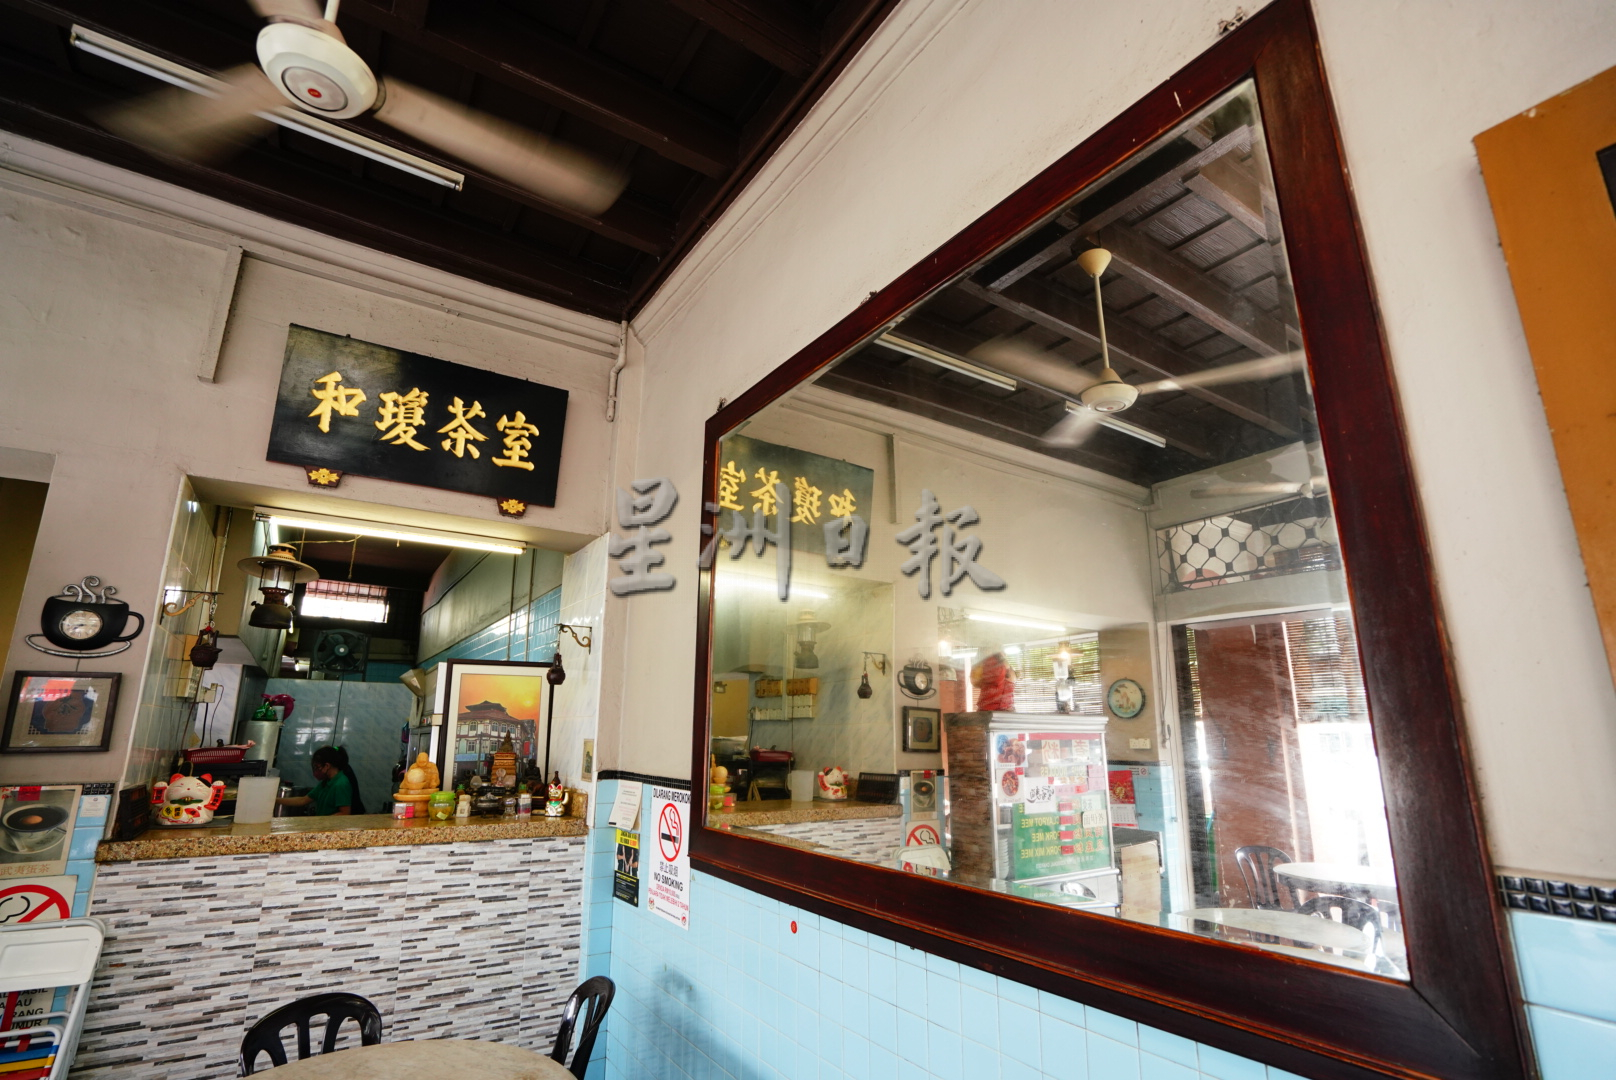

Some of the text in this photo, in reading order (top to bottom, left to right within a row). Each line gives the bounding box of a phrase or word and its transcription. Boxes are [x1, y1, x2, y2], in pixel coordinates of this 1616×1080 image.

[308, 370, 540, 472] 和瓊茶室
[653, 788, 671, 801] DILARANG
[653, 871, 684, 892] NO SMOKING
